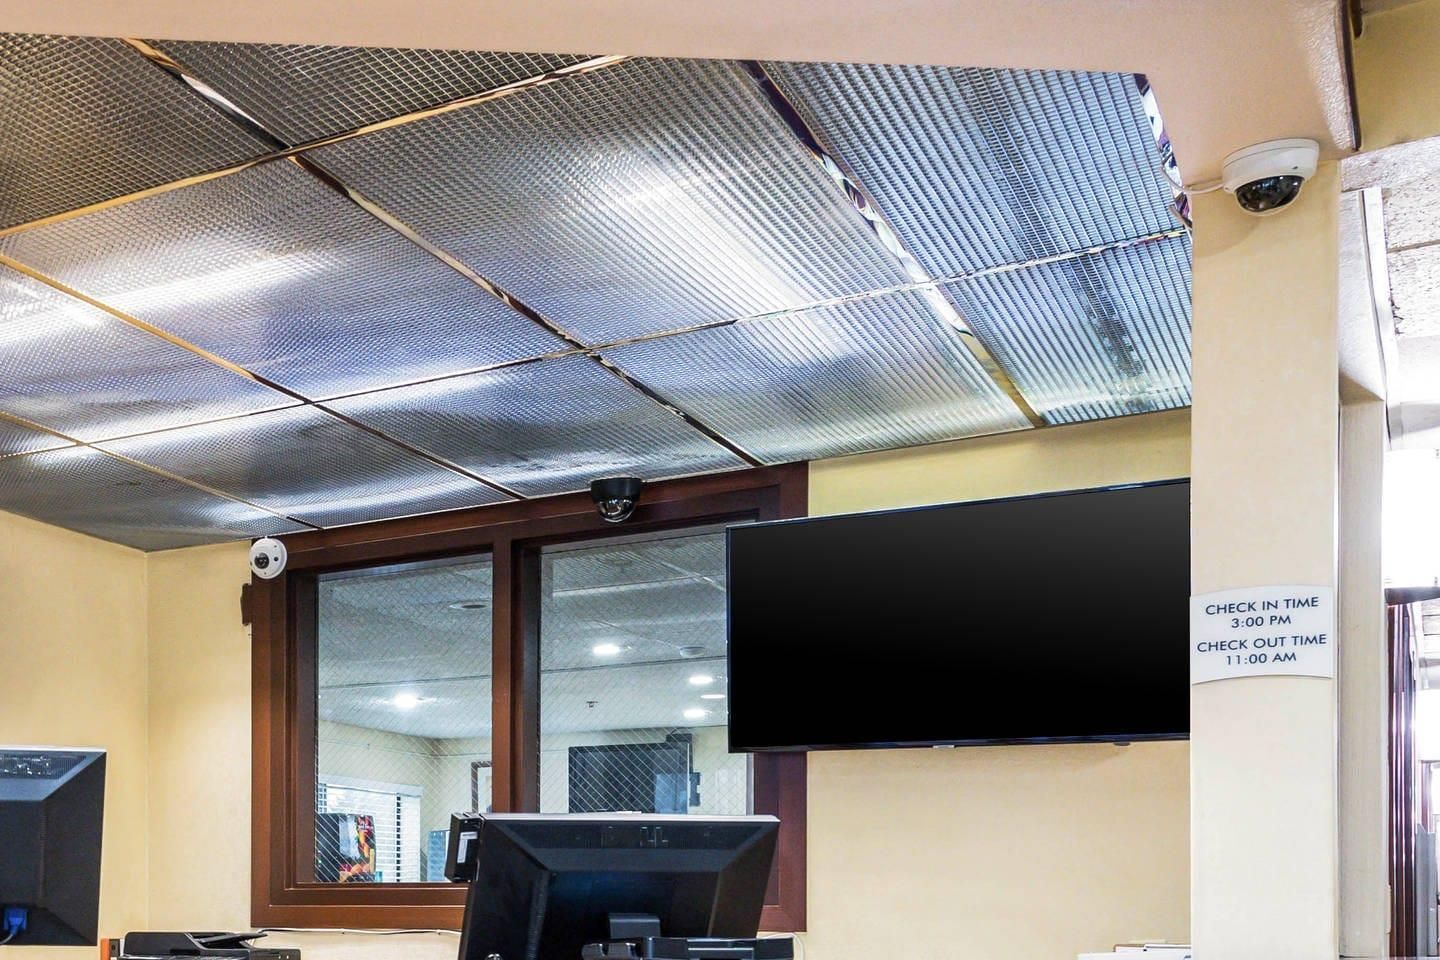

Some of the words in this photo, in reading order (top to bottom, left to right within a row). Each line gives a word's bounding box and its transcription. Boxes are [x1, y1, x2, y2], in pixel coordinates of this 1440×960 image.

[1205, 601, 1257, 615] CHECK
[1262, 599, 1278, 611] IN
[1283, 596, 1319, 609] TIME
[1231, 616, 1264, 628] 3:00
[1269, 615, 1291, 625] PM
[1197, 639, 1248, 652] CHECK
[1253, 636, 1287, 648] OUT
[1291, 633, 1327, 646] TIME
[1226, 653, 1267, 665] 11:00
[1272, 652, 1297, 662] AM
